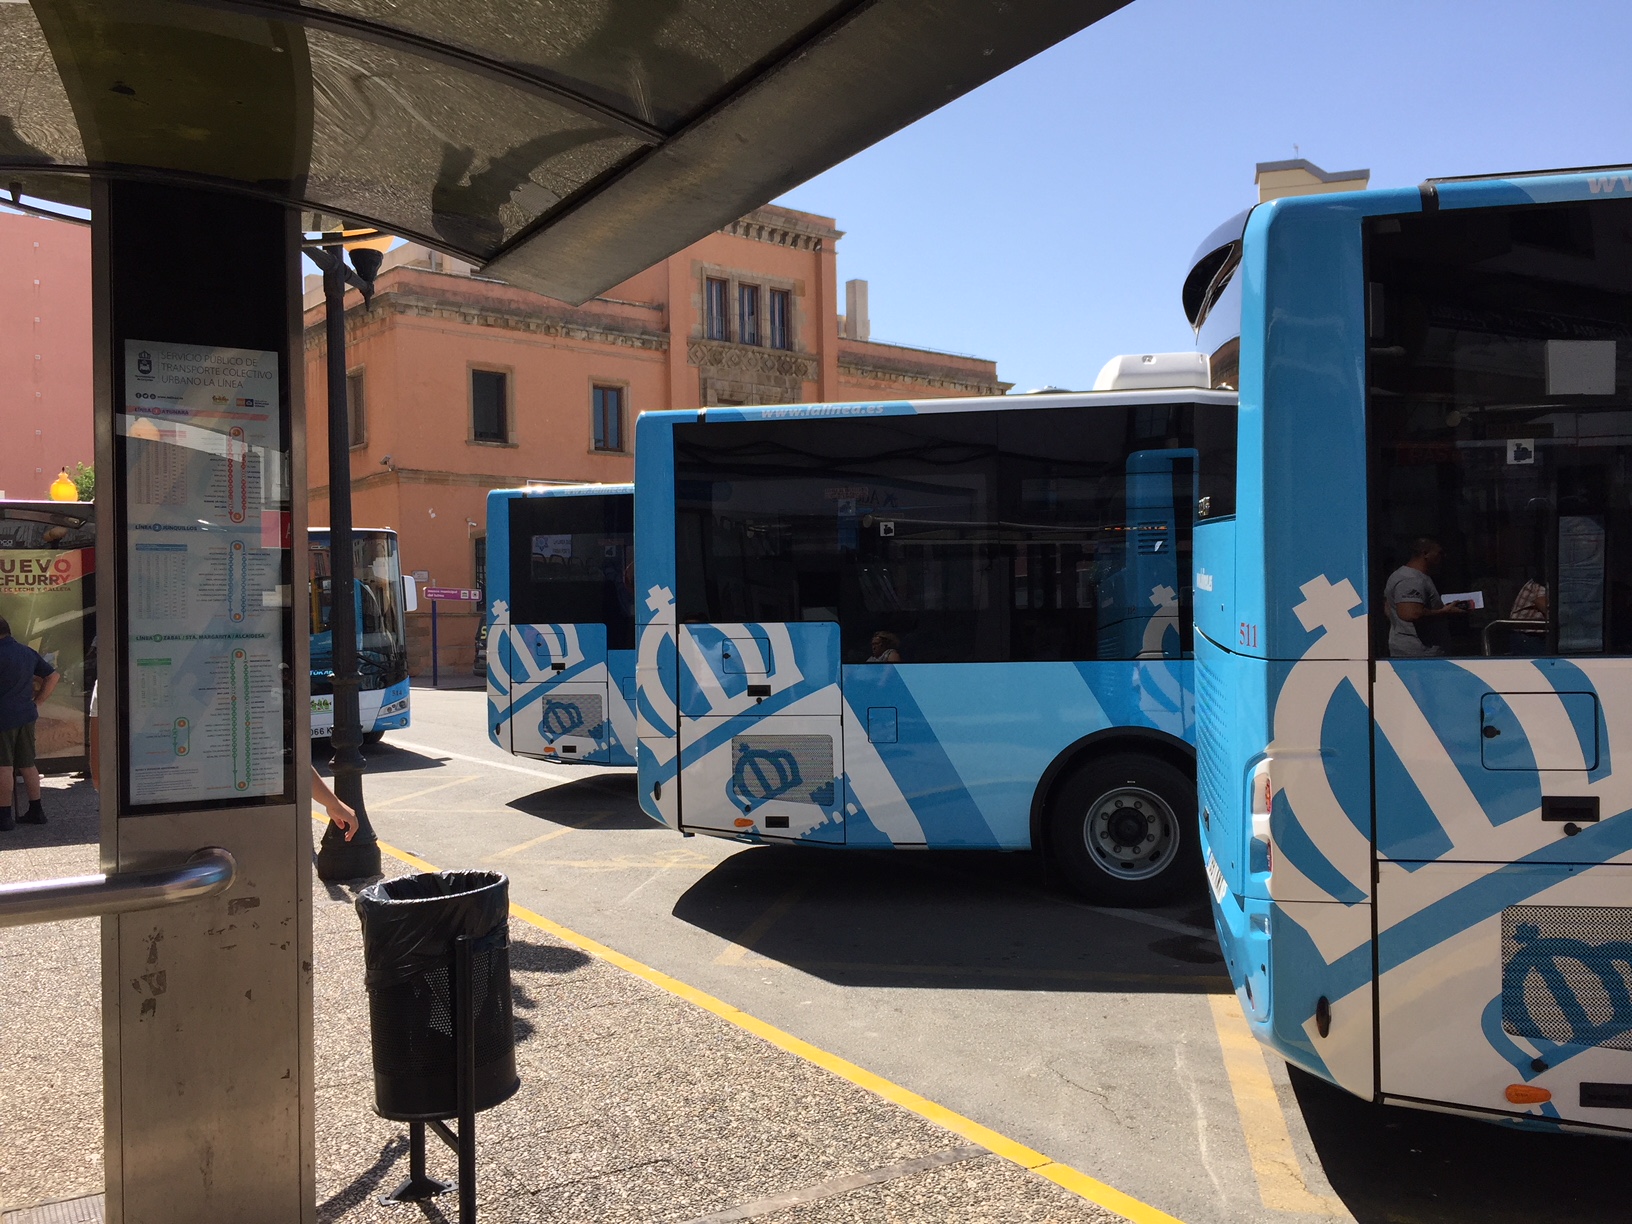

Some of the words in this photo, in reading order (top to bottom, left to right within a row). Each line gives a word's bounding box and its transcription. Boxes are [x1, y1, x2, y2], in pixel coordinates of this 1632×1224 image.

[161, 352, 203, 363] SERVICIO
[204, 353, 243, 366] PÚBLICO
[246, 358, 258, 367] DE
[161, 363, 221, 376] TRANSPORTE
[222, 367, 273, 380] COLECTIVO
[161, 375, 201, 386] URBANO
[203, 377, 215, 387] LA
[217, 378, 243, 389] LÍNEA
[761, 404, 884, 418] www.lalinea.es
[0, 559, 71, 574] UEVO
[1239, 622, 1257, 648] 511
